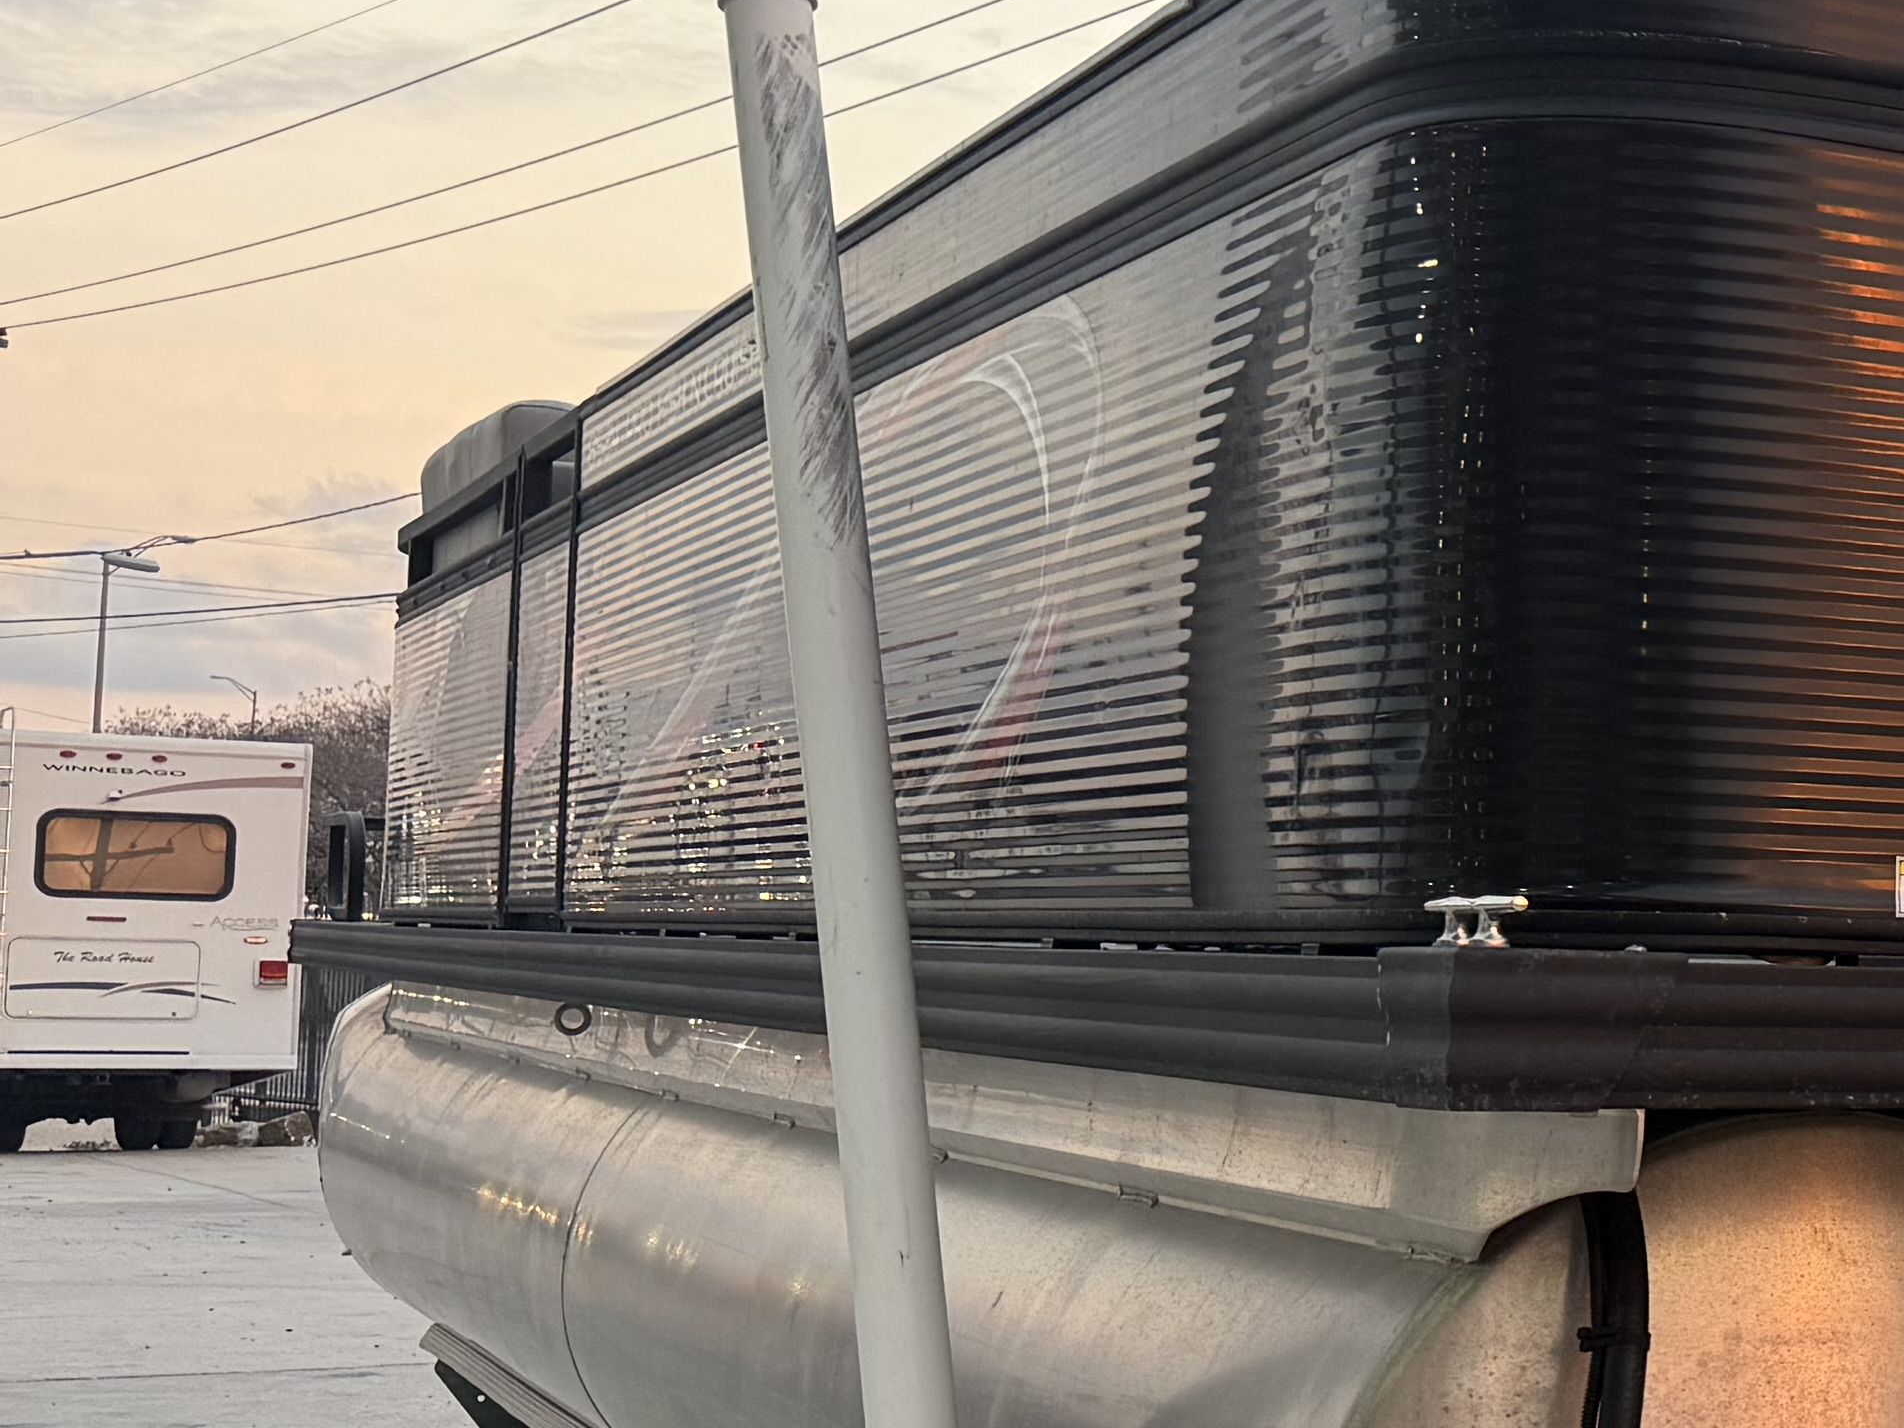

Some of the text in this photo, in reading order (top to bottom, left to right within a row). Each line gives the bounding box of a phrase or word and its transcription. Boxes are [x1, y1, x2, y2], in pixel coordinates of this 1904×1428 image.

[43, 764, 186, 777] WINNEBAGO
[54, 950, 155, 964] The Road House
